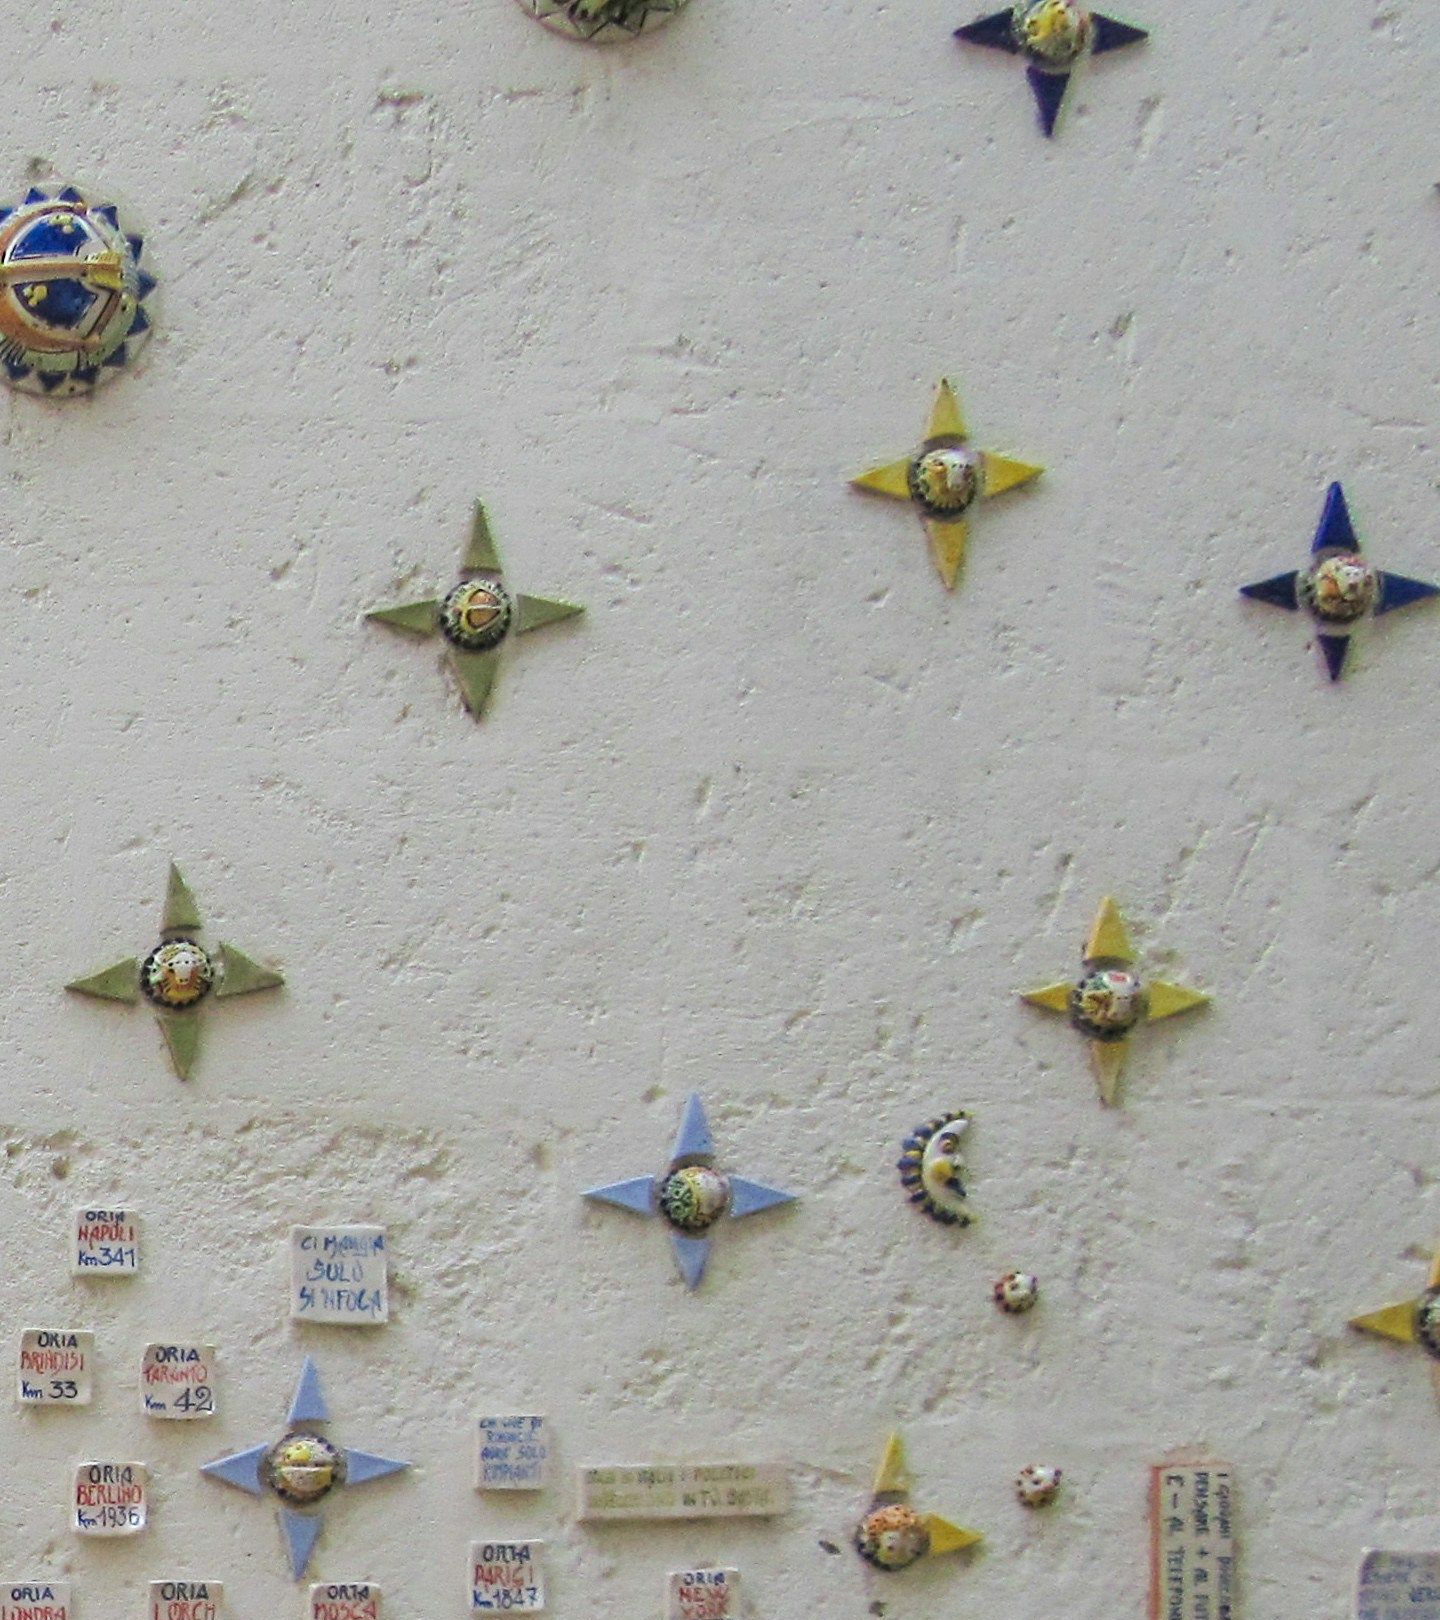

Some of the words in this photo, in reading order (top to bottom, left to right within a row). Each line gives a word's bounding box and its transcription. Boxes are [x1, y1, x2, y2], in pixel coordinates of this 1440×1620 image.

[86, 1211, 124, 1227] ORIA
[79, 1225, 134, 1249] NAPOLI
[38, 1332, 78, 1348] ORIA
[156, 1347, 200, 1362] ORIA
[90, 1466, 133, 1484] ORIA
[77, 1485, 142, 1505] BERLINO
[483, 1545, 531, 1562] ORIA
[11, 1587, 54, 1602] ORIA
[162, 1583, 209, 1601] ORIA
[328, 1585, 369, 1600] ORIA
